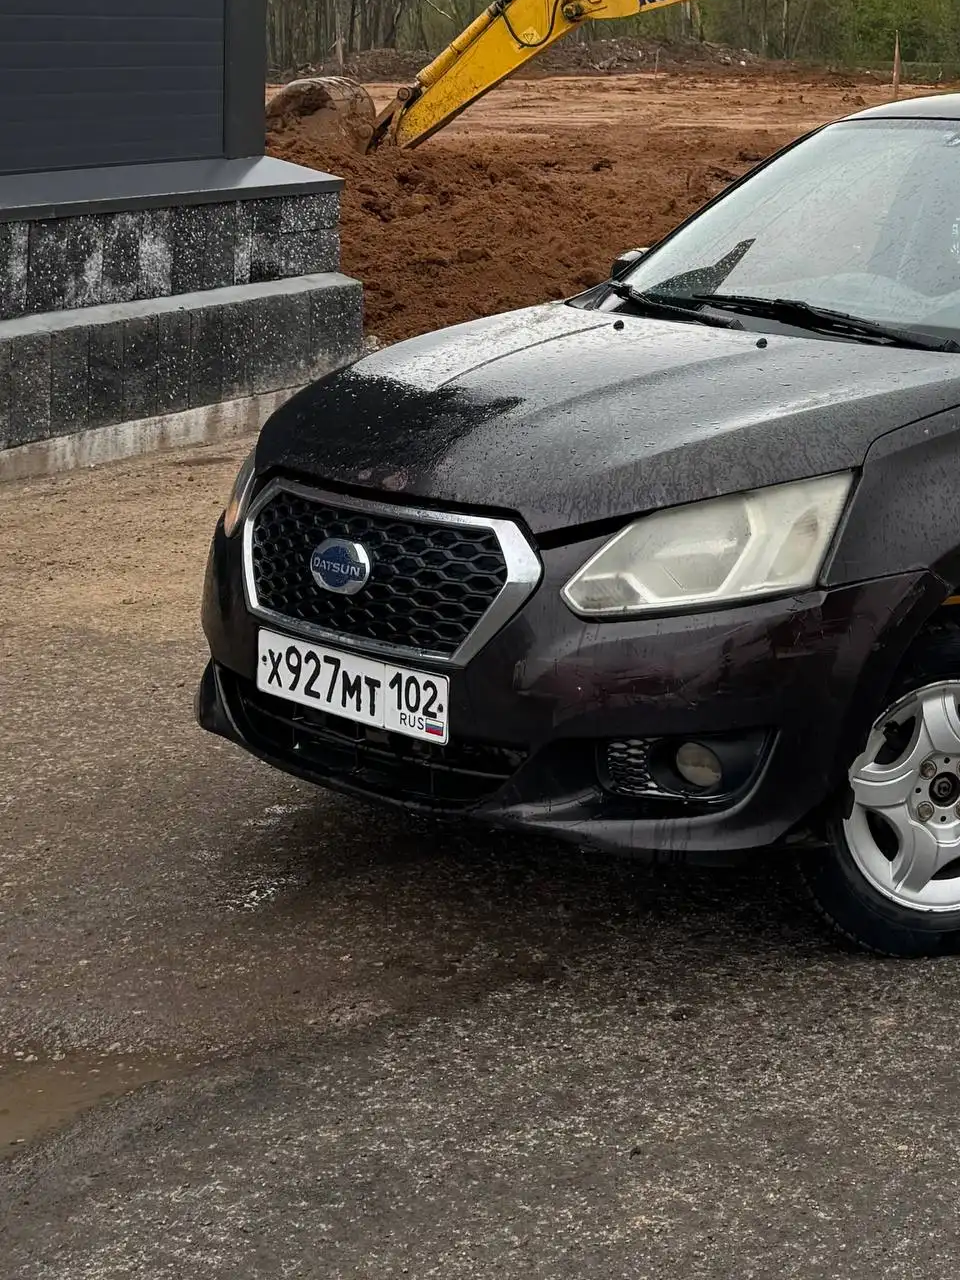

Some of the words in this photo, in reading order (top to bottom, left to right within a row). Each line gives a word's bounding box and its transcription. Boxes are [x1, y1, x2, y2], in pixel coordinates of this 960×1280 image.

[313, 556, 360, 577] DATSUN
[389, 672, 437, 718] 102
[399, 712, 424, 731] RUS
